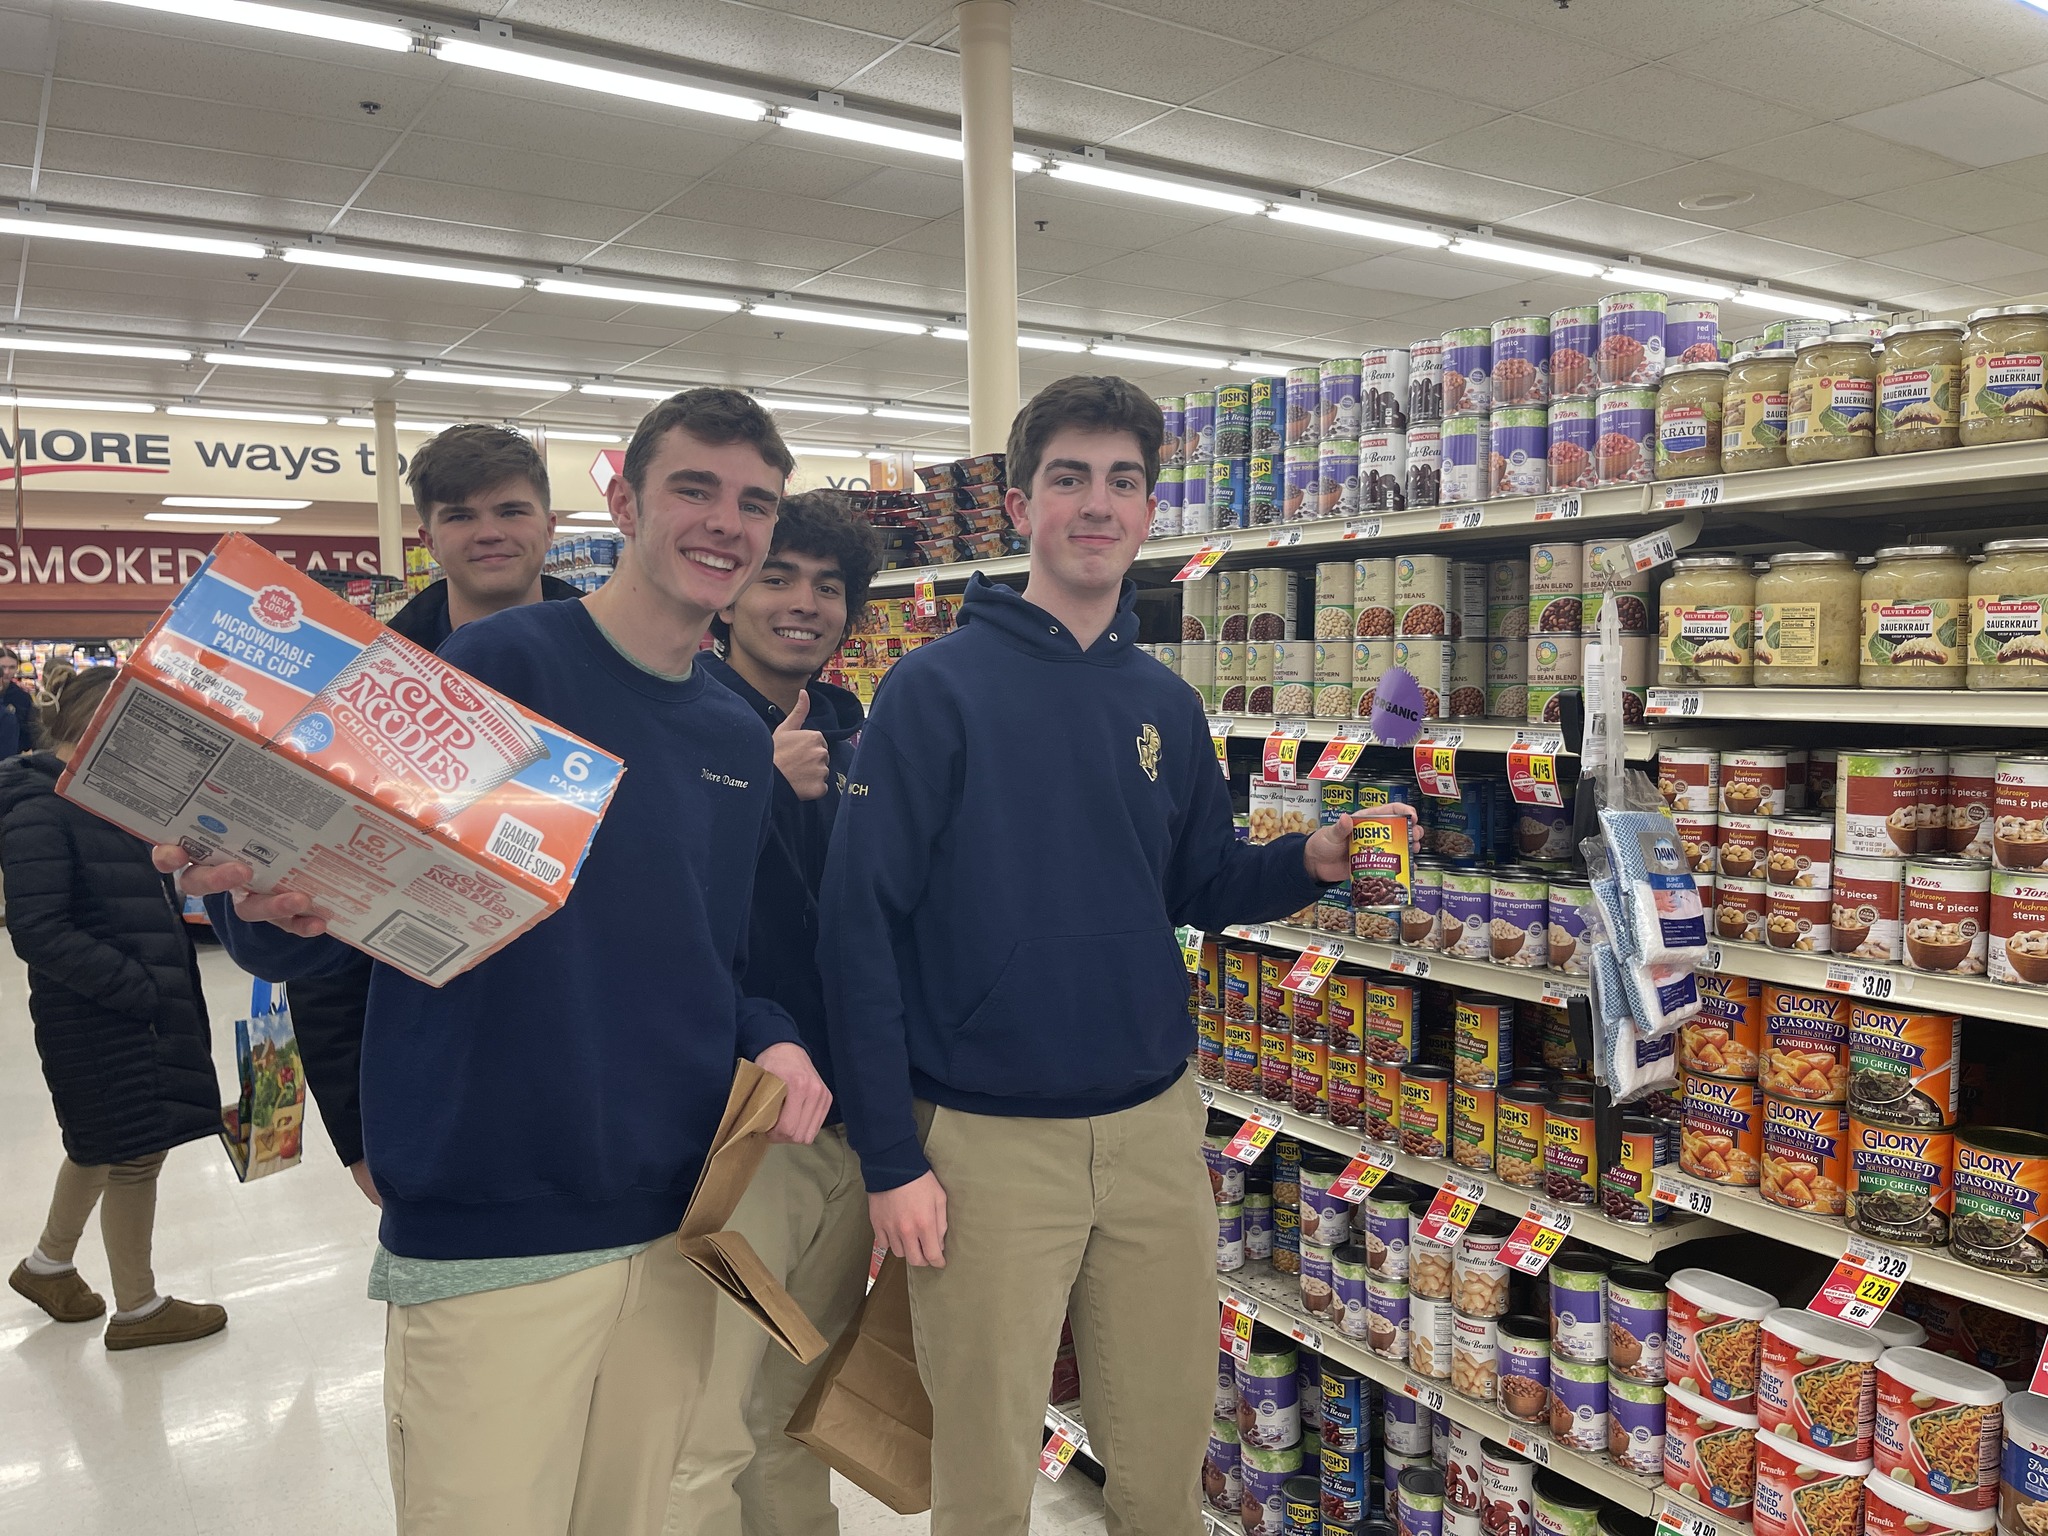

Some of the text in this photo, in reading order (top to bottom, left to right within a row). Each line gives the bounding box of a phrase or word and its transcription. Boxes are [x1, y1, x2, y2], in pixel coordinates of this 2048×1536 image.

[1989, 373, 2041, 383] SAUERKRAUT
[1219, 392, 1247, 404] BUSH'S
[1883, 388, 1928, 400] SAUERKRAUT
[1661, 425, 1706, 438] KRAUT
[0, 428, 171, 465] MORE
[195, 441, 341, 480] ways
[887, 459, 898, 487] 5
[1701, 488, 1718, 504] $2.19
[1561, 501, 1579, 518] $1.09
[1463, 513, 1481, 527] $1.09
[1654, 541, 1674, 560] $4.49
[0, 544, 206, 584] SMOKED
[263, 600, 290, 618] LOOK!
[270, 594, 291, 608] NEW
[1683, 626, 1727, 635] SAUERKRAUT
[1880, 623, 1930, 632] SAUERKRAUT
[1986, 619, 2038, 629] SAUERKRAUT
[212, 609, 315, 668] MICROWAVABLE
[212, 630, 300, 678] PAPER CUP
[381, 658, 397, 669] The
[177, 672, 192, 685] NET
[193, 681, 208, 692] WT
[225, 699, 238, 710] OZ
[191, 667, 203, 678] OZ
[223, 685, 244, 701] CUPS
[443, 677, 479, 711] NISSIN
[391, 677, 475, 750] CUP
[1374, 697, 1419, 722] ORGANIC
[1682, 699, 1699, 715] $3.09
[310, 719, 323, 730] NO
[338, 673, 469, 792] NOODLES
[300, 724, 327, 743] ADDED
[182, 737, 216, 757] 290
[338, 711, 409, 776] CHICKEN
[563, 751, 593, 781] 6
[1435, 755, 1450, 771] 4/$5
[1533, 763, 1550, 779] 4/$5
[549, 774, 588, 800] PACK
[701, 768, 749, 789] Notre Dame
[1323, 788, 1352, 801] BUSH'S
[1893, 789, 1916, 797] stems
[1958, 789, 1987, 798] pieces
[1996, 787, 2029, 797] Mushrooms
[500, 821, 540, 852] RAMEN
[1353, 827, 1390, 840] BUSH'S
[355, 840, 386, 859] PACK
[366, 835, 390, 850] 6
[491, 837, 532, 871] NOODLE
[532, 858, 562, 883] SOUP
[1351, 855, 1397, 864] Chili Beans
[1655, 847, 1680, 862] DAWN
[423, 867, 515, 919] NOODLES
[1910, 890, 1946, 902] Mushrooms
[1494, 901, 1508, 909] great
[1723, 900, 1746, 908] buttons
[1910, 900, 1978, 914] stems & pieces
[2013, 911, 2045, 922] stems
[1186, 953, 1196, 965] 10¢
[1415, 961, 1429, 976] 99¢
[1863, 976, 1892, 998] $3.09
[1777, 994, 1839, 1019] GLORY
[1771, 1016, 1845, 1038] SEASONED
[1851, 1008, 1909, 1039] GLORY
[1776, 1037, 1836, 1053] CANDIED YAMS
[1329, 1059, 1356, 1074] BUSH'S
[1870, 1059, 1908, 1075] GREENS
[1401, 1084, 1430, 1101] BUSH'S
[1685, 1077, 1738, 1106] GLORY
[1682, 1098, 1743, 1123] SEASONED
[1767, 1100, 1823, 1130] GLORY
[1546, 1122, 1578, 1141] BUSH'S
[1763, 1122, 1829, 1149] SEASONED
[1862, 1129, 1930, 1158] GLORY
[1557, 1150, 1584, 1165] Beans
[1766, 1143, 1819, 1164] CANDIED YAMS
[1857, 1152, 1935, 1178] SEASONED
[1958, 1149, 2024, 1182] GLORY
[1361, 1170, 1381, 1184] 3/$5
[1611, 1167, 1637, 1182] Beans
[1468, 1184, 1484, 1200] $2.29
[1860, 1175, 1929, 1195] MIXED GREENS
[1955, 1172, 2029, 1204] SEASONED
[1689, 1192, 1711, 1214] $5.79
[1956, 1196, 2021, 1221] MIXED GREENS
[1451, 1204, 1471, 1222] 3/$5
[1554, 1213, 1571, 1231] $2.29
[1534, 1234, 1558, 1251] 3/$5
[1525, 1255, 1541, 1266] $1.87
[1878, 1255, 1907, 1278] $3.29
[1862, 1280, 1891, 1302] $2.79
[1850, 1305, 1869, 1318] 50¢
[1236, 1319, 1248, 1335] 4/$5
[1762, 1349, 1788, 1363] French's
[1760, 1379, 1779, 1395] FRIED
[1761, 1370, 1784, 1388] CRISPY
[1428, 1390, 1443, 1410] $1.79
[1758, 1389, 1788, 1408] ONIONS
[1876, 1389, 1903, 1404] French's
[1331, 1408, 1350, 1420] Beans
[1667, 1413, 1690, 1426] French's
[1534, 1443, 1548, 1464] $1.09
[1760, 1461, 1787, 1476] French's
[1493, 1479, 1518, 1494] Beans
[1758, 1482, 1784, 1500] CRISPY
[1757, 1491, 1778, 1507] FRIED
[1288, 1507, 1318, 1520] BUSH'S
[1756, 1501, 1788, 1521] ONIONS
[1867, 1511, 1896, 1528] French's
[1540, 1512, 1563, 1531] TOPS
